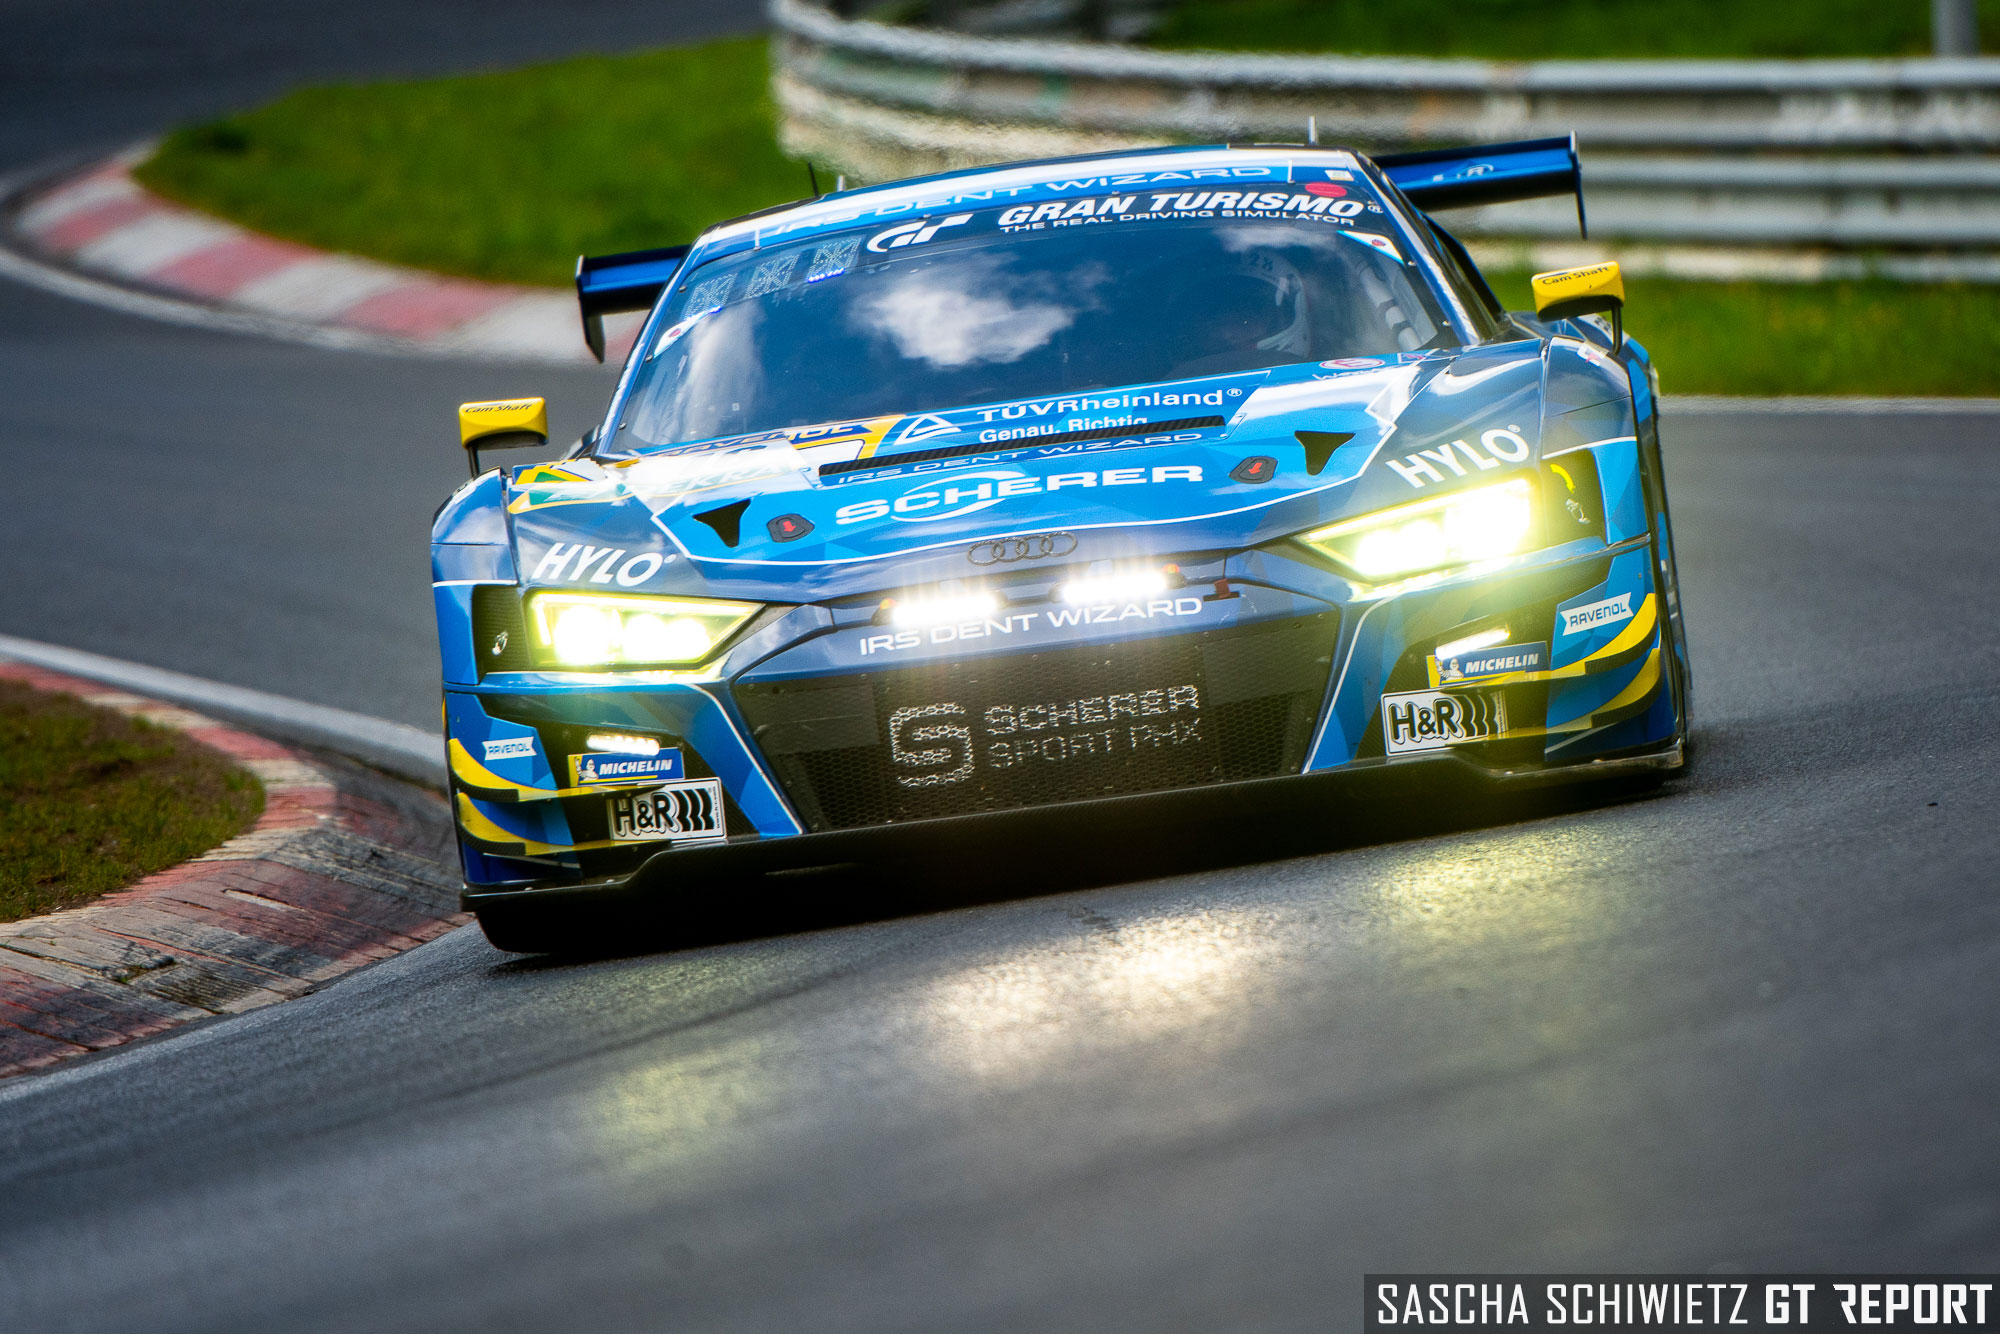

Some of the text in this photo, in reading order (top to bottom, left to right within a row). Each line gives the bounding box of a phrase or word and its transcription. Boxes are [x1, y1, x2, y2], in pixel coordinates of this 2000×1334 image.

[874, 185, 1034, 216] DENT
[1046, 165, 1271, 191] WIZARD
[996, 196, 1137, 227] GRAN
[1000, 210, 1355, 234] THE REAL DRIVING SIMULATOR
[1542, 266, 1609, 285] Cam Shaft
[495, 403, 532, 411] Shaft
[1068, 415, 1148, 432] Richtig
[838, 433, 1203, 484] IRS DENT WIZARD
[835, 465, 1204, 526] SCHERER
[860, 597, 1204, 656] IRS DENT WIZARD
[1569, 601, 1627, 628] RAVENOL
[1465, 653, 1539, 673] MICHELIN
[984, 684, 1200, 735] SCHERER
[1387, 696, 1464, 743] H&R
[488, 743, 530, 755] RAVENOL
[889, 701, 975, 788] S
[990, 717, 1202, 768] SPORT PHX
[600, 759, 673, 775] MICHELIN
[615, 791, 679, 836] H&R
